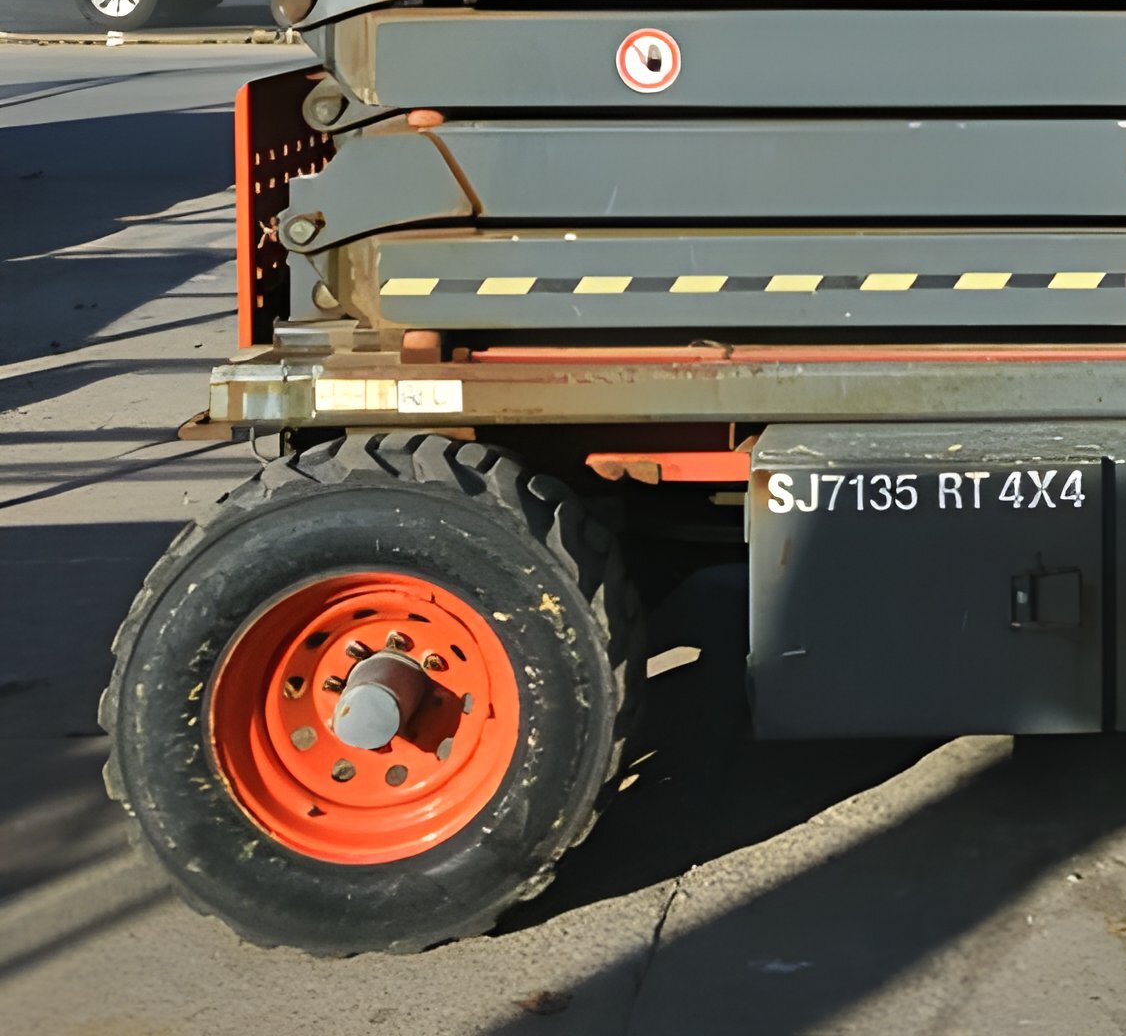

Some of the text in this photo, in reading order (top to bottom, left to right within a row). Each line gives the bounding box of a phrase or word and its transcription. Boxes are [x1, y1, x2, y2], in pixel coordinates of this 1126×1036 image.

[767, 468, 1087, 514] SJ7135 RT 4X4
